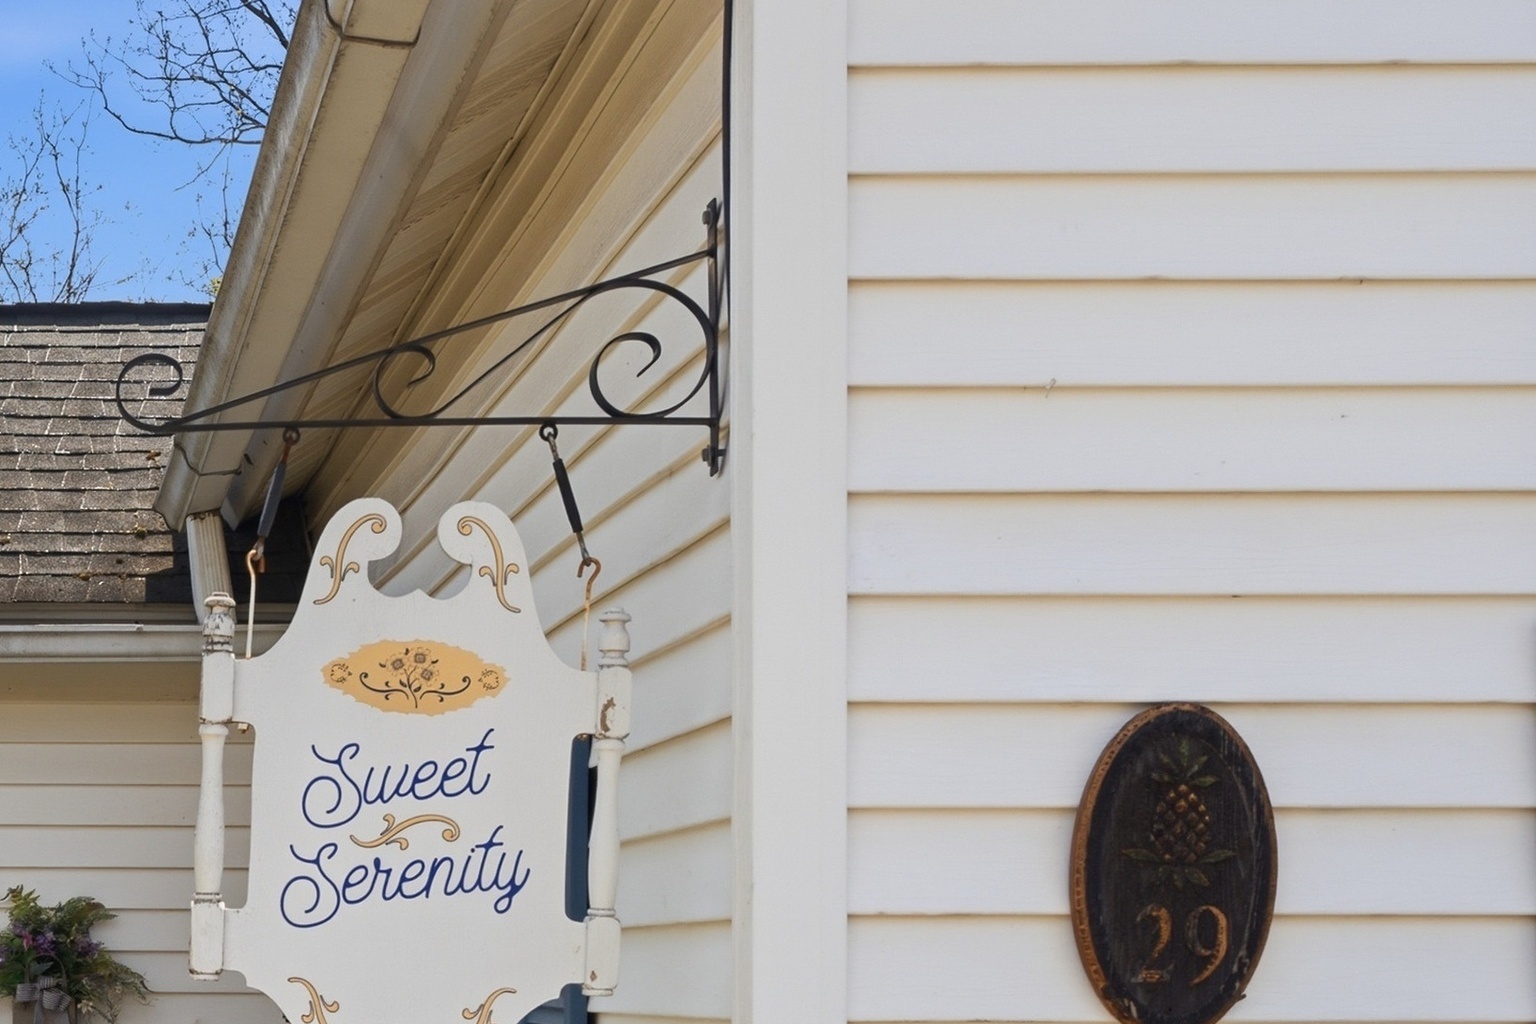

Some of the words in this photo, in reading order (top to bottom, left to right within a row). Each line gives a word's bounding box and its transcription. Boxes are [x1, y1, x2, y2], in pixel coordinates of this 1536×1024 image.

[302, 728, 495, 828] Sweet
[280, 825, 531, 928] Serenity
[1131, 903, 1230, 987] 29
